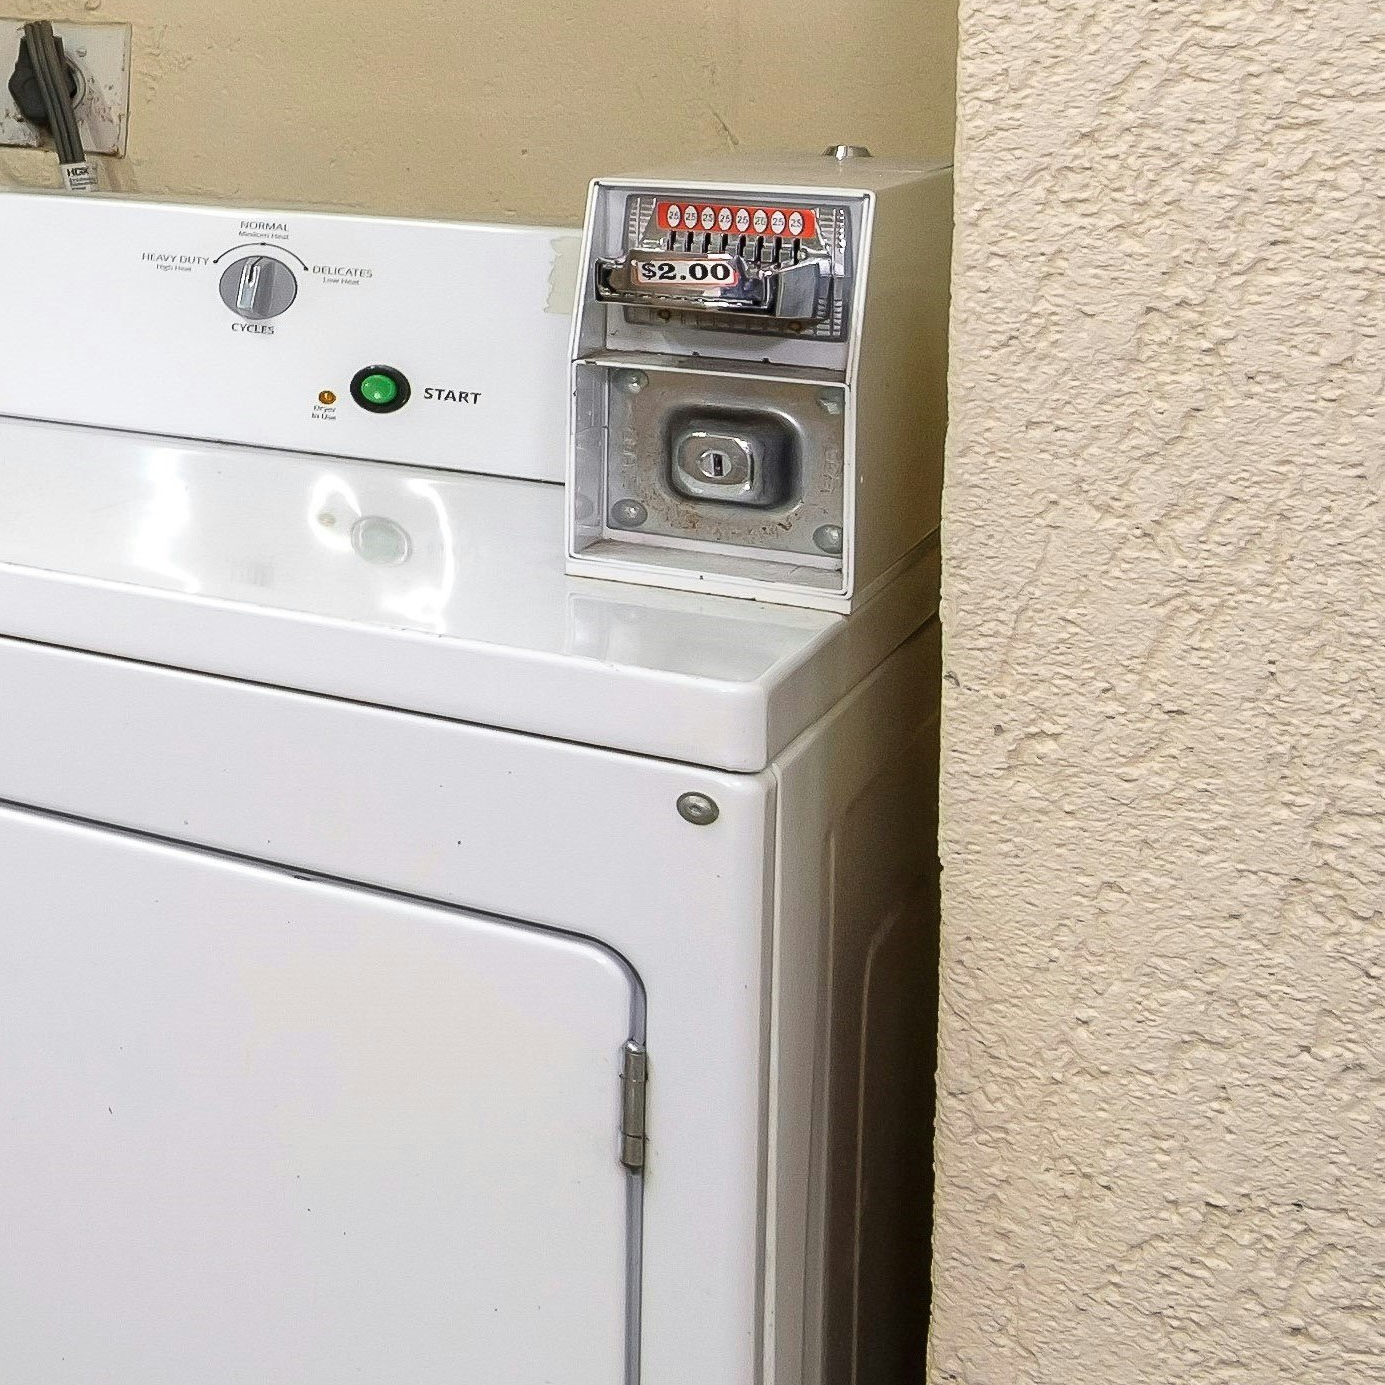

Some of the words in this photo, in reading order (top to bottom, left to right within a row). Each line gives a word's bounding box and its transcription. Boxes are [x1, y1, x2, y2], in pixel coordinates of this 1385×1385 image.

[240, 220, 289, 233] NORMAL
[141, 252, 177, 264] HEAVY
[179, 255, 210, 267] DUTY
[312, 265, 374, 279] DELICATES
[641, 261, 731, 281] $2.00
[230, 322, 275, 335] CYCLES
[423, 387, 482, 405] START
